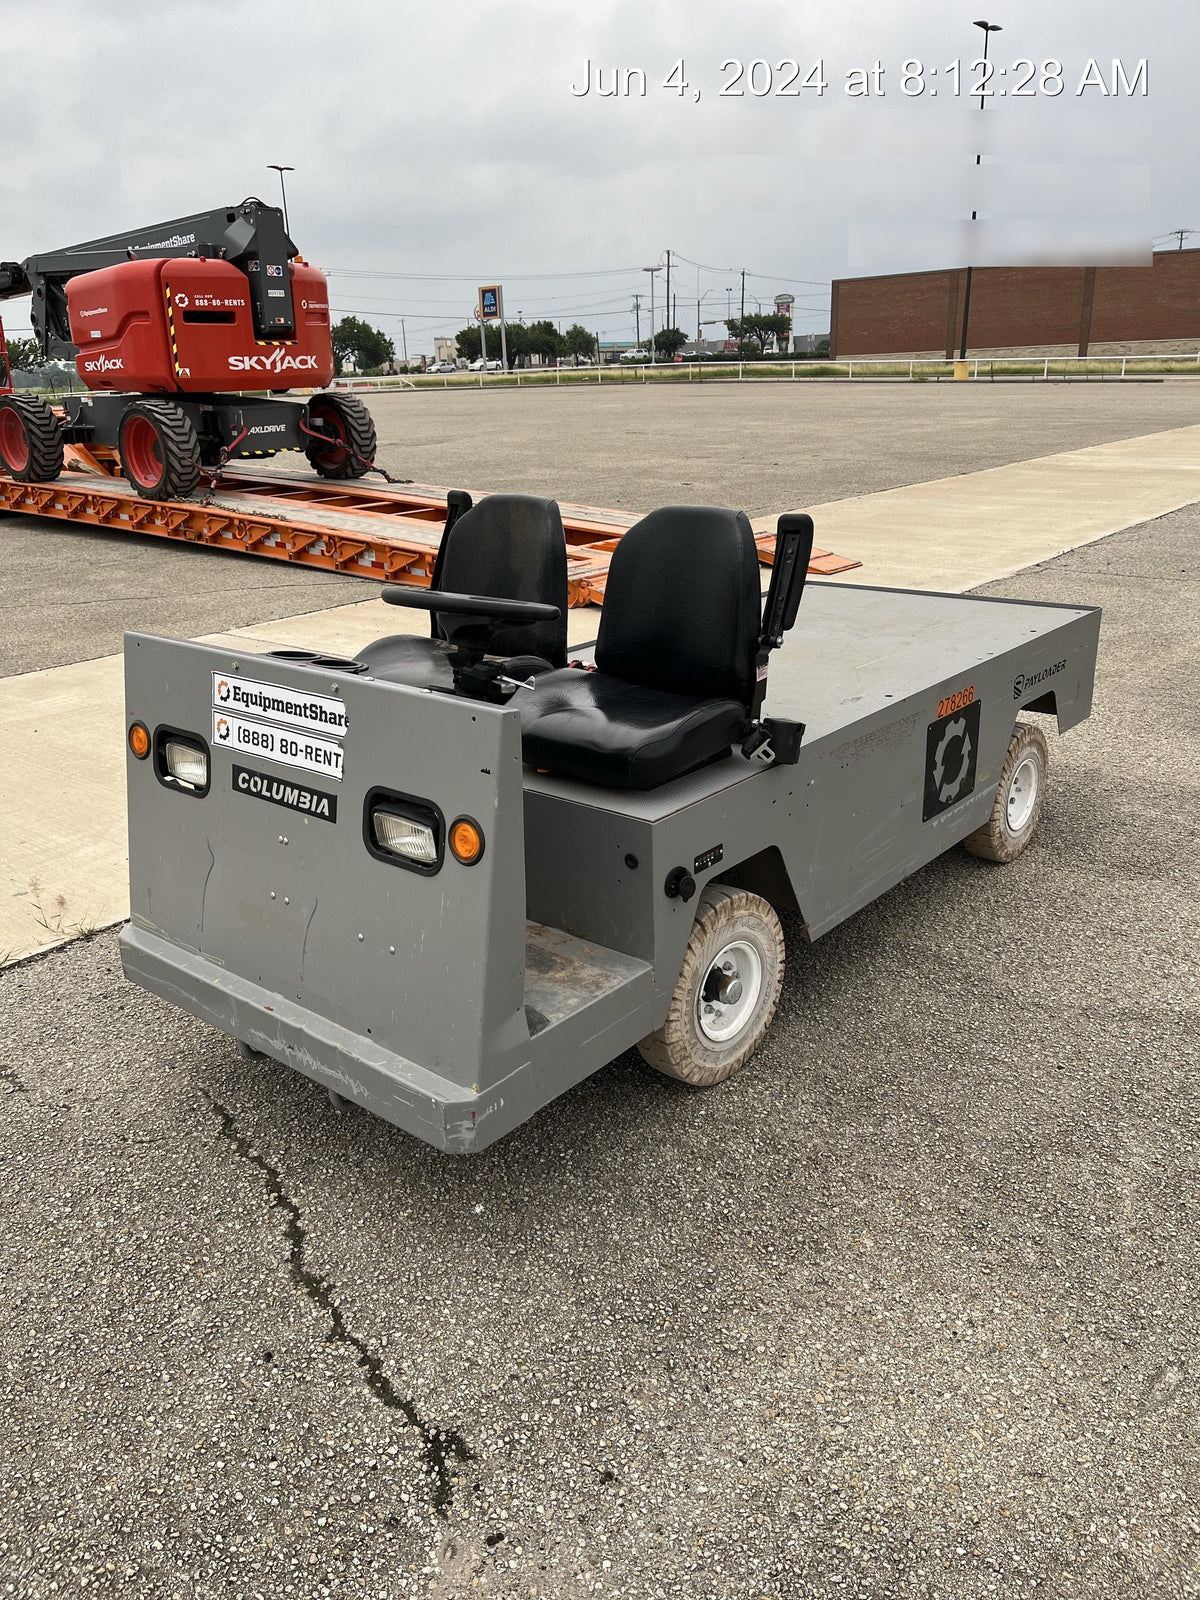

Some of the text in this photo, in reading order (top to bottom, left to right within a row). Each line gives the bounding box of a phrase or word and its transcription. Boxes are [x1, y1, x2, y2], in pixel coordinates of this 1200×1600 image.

[194, 299, 245, 307] 888-80-RENTS
[84, 354, 124, 373] SKYJACK
[227, 347, 319, 374] SKYJACK
[1024, 659, 1067, 690] PAYLOADER
[937, 685, 975, 719] 278266
[237, 725, 274, 752] (888)
[237, 772, 330, 817] COLUMBIA
